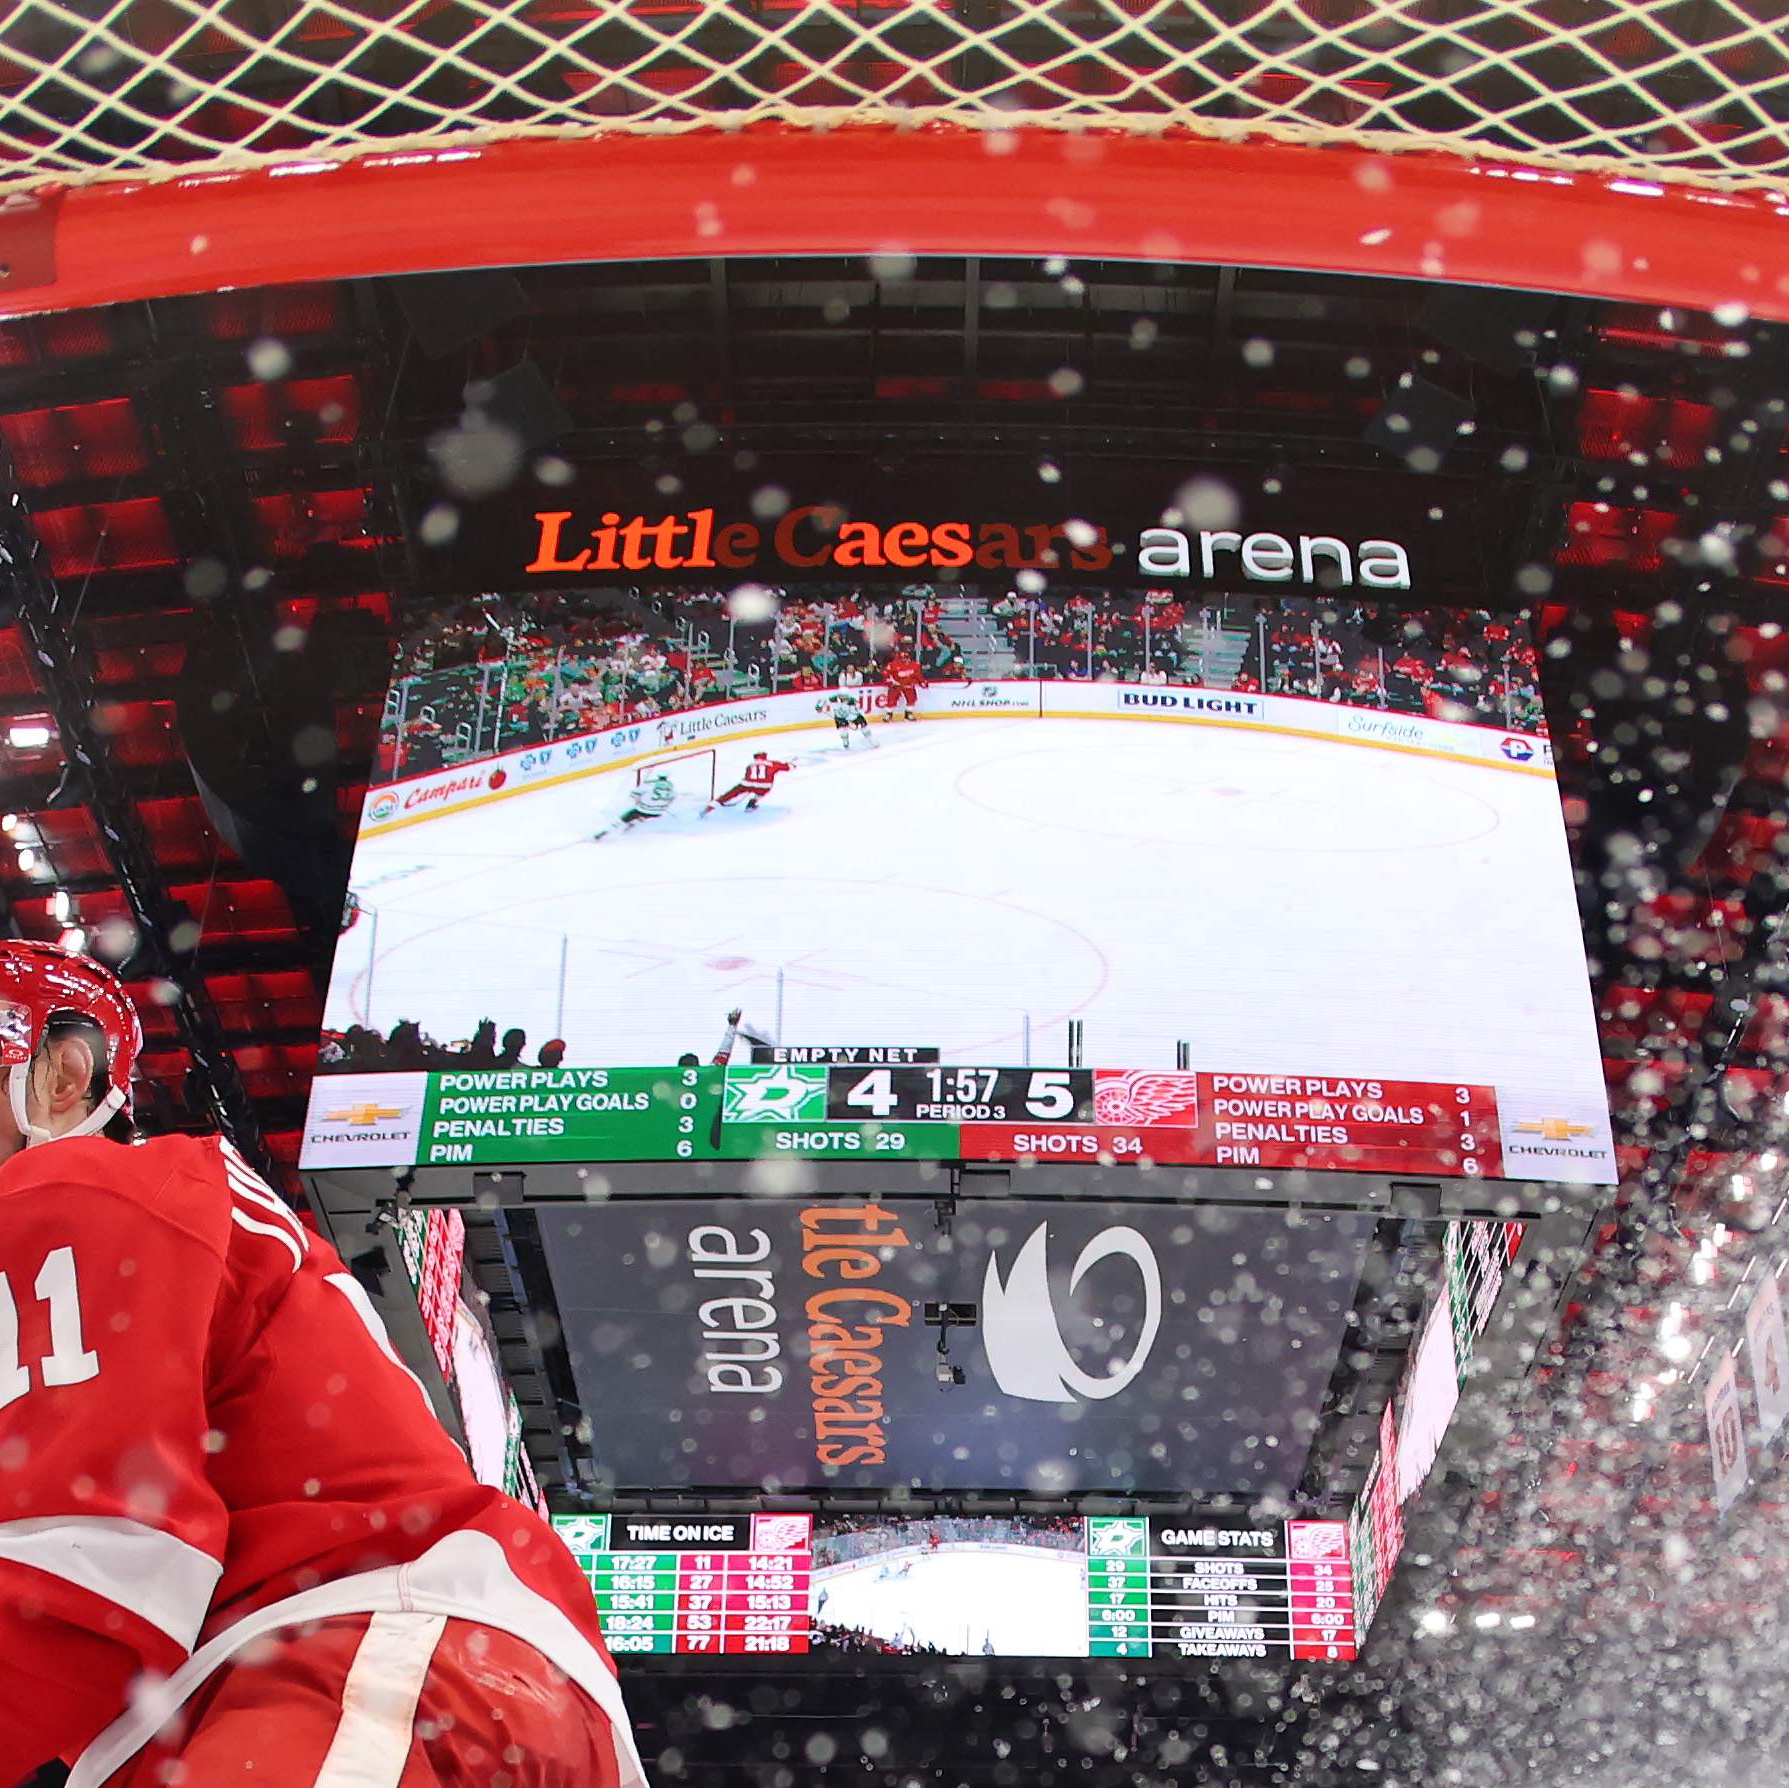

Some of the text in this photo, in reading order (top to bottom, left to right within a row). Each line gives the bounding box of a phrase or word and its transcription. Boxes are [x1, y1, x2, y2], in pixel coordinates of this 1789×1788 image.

[526, 506, 1412, 590] Little Caesars arena
[1124, 693, 1257, 715] BUD LIGHT
[679, 708, 767, 736] Little Caesars
[1348, 715, 1424, 741] Surfside
[404, 770, 484, 810] Campari
[774, 1048, 918, 1063] EMPTY NET
[440, 1070, 698, 1092] POWER PLAYS 3
[926, 1069, 998, 1103] 1:57
[847, 1070, 897, 1116] 4
[1025, 1072, 1073, 1120] 5
[1213, 1075, 1469, 1104] POWER PLAYS 3
[439, 1093, 697, 1114] POWER PLAY GOALS 0
[916, 1104, 1006, 1119] PERIOD 3
[1214, 1100, 1469, 1127] POWER PLAY GOALS 1
[434, 1117, 694, 1138] PENALTIES 3
[311, 1131, 411, 1143] CHEVROLET
[776, 1132, 905, 1150] SHOTS 29
[1014, 1134, 1142, 1154] SHOTS 34
[1215, 1123, 1475, 1150] PENALTIES 3
[430, 1140, 692, 1161] PIM 6
[1508, 1145, 1608, 1159] CHEVROLET
[1216, 1146, 1478, 1175] PIM 6
[688, 1225, 783, 1393] arena
[804, 1288, 911, 1466] Caesars
[627, 1525, 734, 1541] TIME ON ICE
[1161, 1530, 1274, 1547] GAME STATS
[612, 1556, 793, 1570] 17:27 11 14:21
[1106, 1560, 1125, 1572] 29
[1195, 1562, 1244, 1574] SHOTS
[1314, 1565, 1332, 1575] 34
[611, 1576, 794, 1589] 16:15 27 14:52
[1108, 1577, 1125, 1589] 37
[1183, 1578, 1258, 1591] FACEOFFS
[1316, 1581, 1334, 1592] 25
[610, 1594, 791, 1609] 15:41 37 15:13
[1110, 1594, 1125, 1604] 17
[1204, 1594, 1237, 1606] HITS
[1316, 1597, 1335, 1608] 20
[687, 1615, 791, 1630] 53 22:17
[1102, 1610, 1135, 1621] 6:00
[1208, 1610, 1234, 1622] PIM
[1311, 1614, 1344, 1625] 6:00
[1111, 1626, 1127, 1637] 12
[1180, 1627, 1264, 1640] GIVEAWAYS
[1322, 1630, 1336, 1641] 17
[606, 1636, 789, 1651] 16:05 77 21:18
[1116, 1643, 1127, 1655] 4
[1178, 1644, 1266, 1657] TAKEAWAYS
